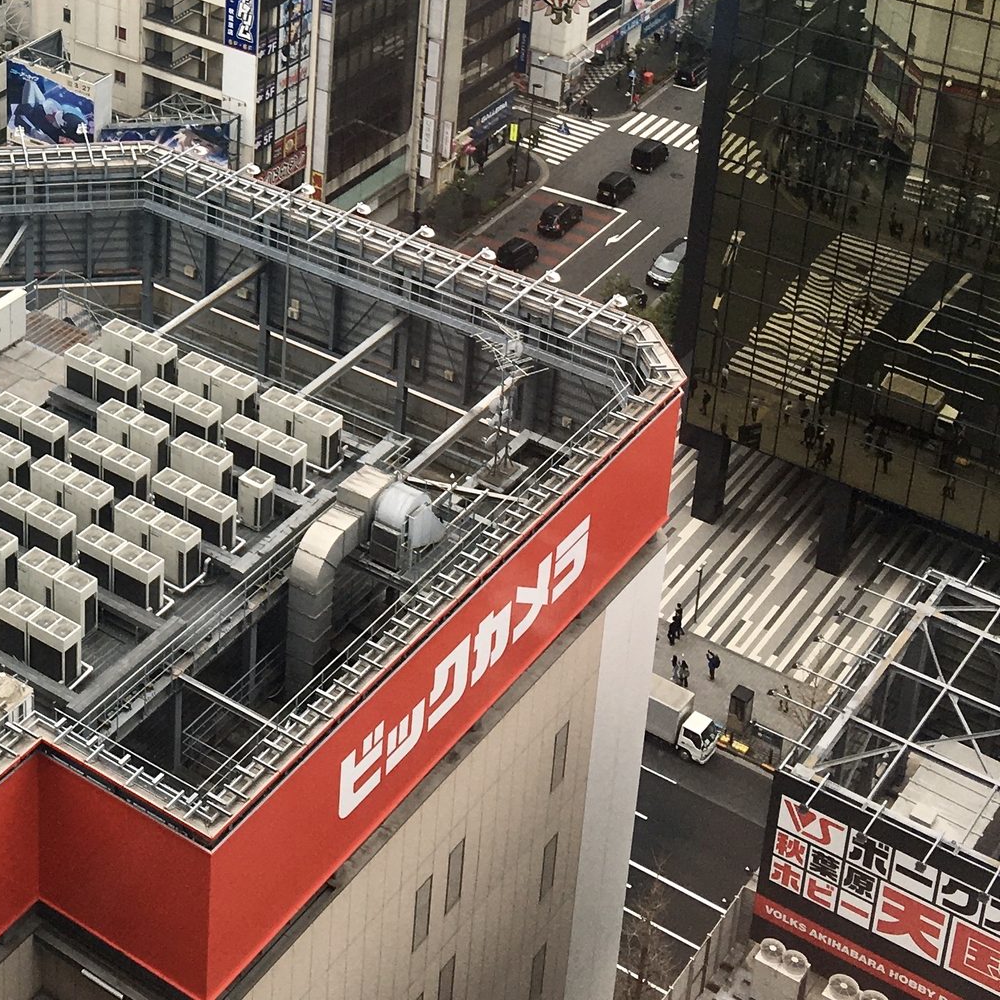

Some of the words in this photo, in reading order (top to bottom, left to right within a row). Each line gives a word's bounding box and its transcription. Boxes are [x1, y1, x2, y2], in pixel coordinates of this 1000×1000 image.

[266, 41, 278, 56] 7F
[337, 514, 592, 819] ビックカメラ
[771, 862, 870, 919] ホビー
[775, 831, 877, 900] 秋葉原
[765, 904, 808, 933] VOLKS
[809, 928, 886, 975] AKIHABARA
[889, 968, 936, 999] HOBBY
